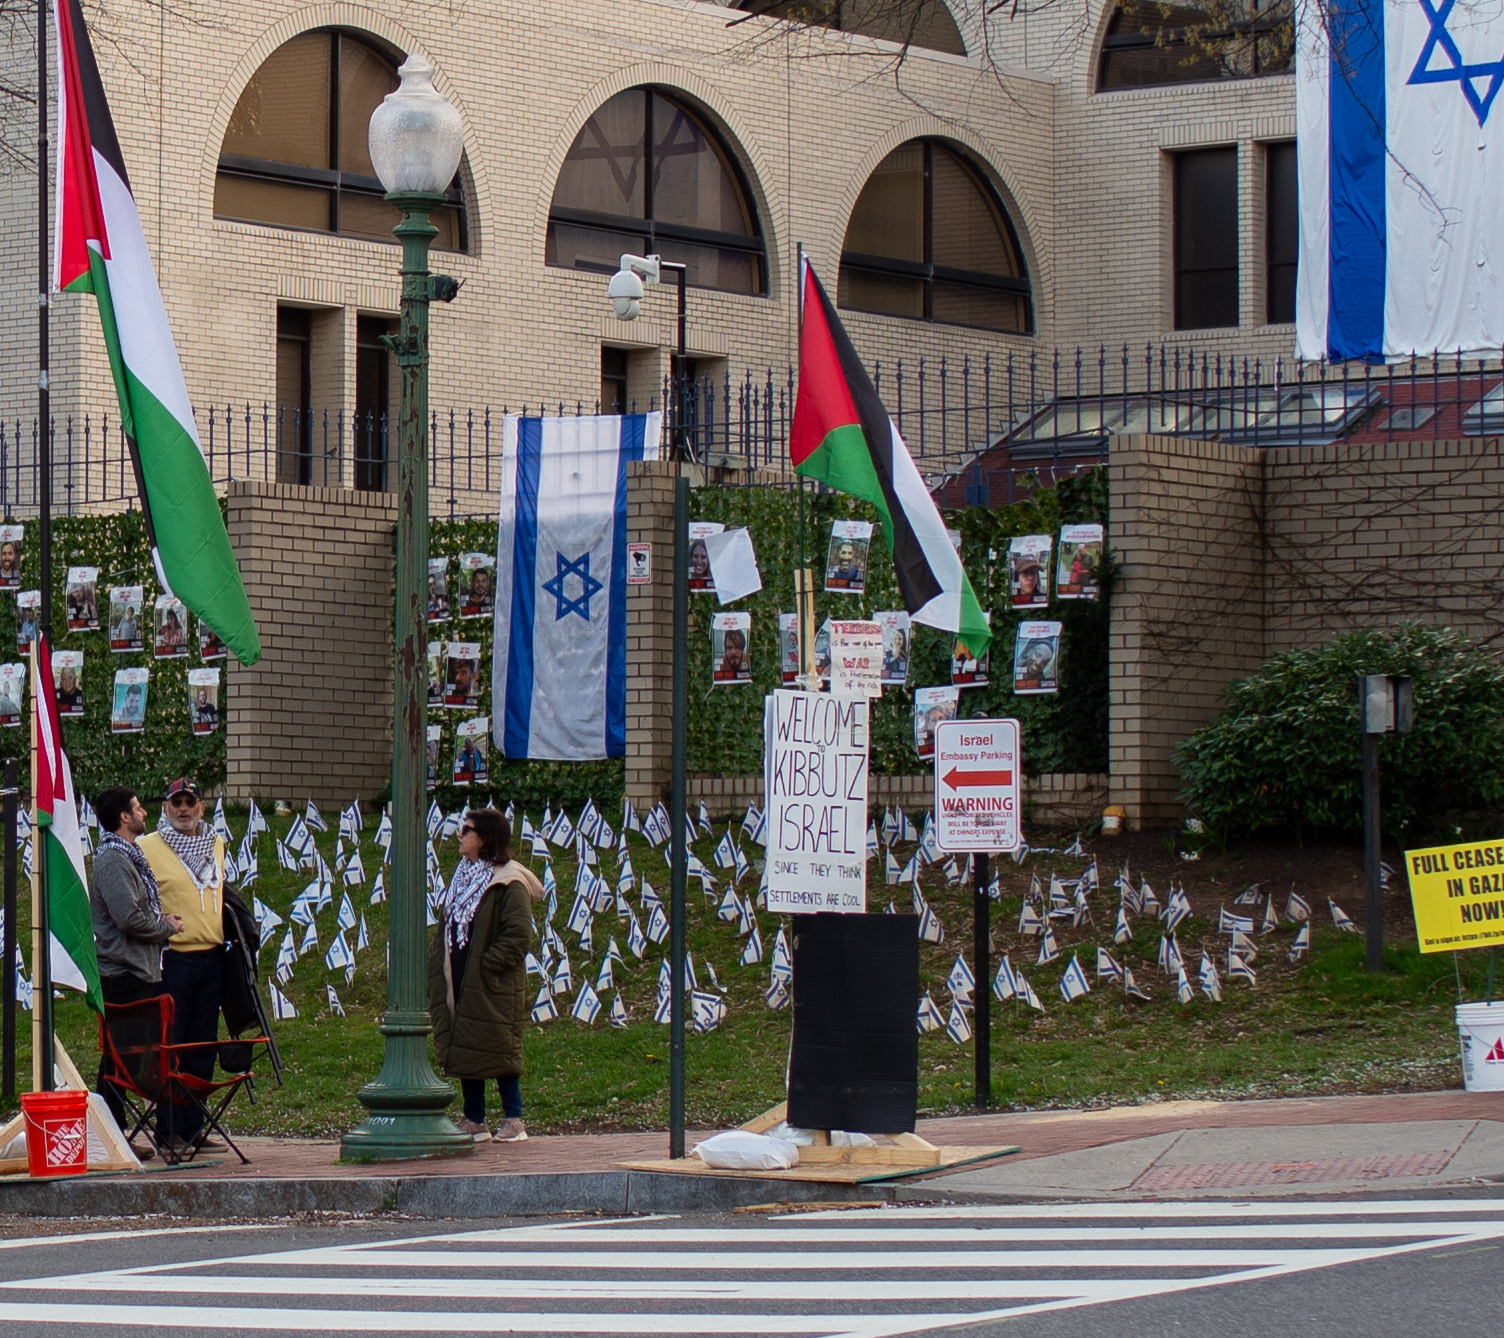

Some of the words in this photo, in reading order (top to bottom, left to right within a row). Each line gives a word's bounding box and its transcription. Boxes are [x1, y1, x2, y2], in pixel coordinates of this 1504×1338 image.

[843, 657, 869, 669] WAR
[777, 695, 866, 748] WELCOME
[818, 744, 825, 753] TO
[960, 734, 993, 746] Israel
[941, 752, 978, 761] Embassy
[981, 751, 1012, 761] Parking
[773, 749, 866, 801] KIBBUTZ
[942, 797, 1013, 811] WARNING
[779, 804, 856, 854] ISRAEL
[774, 861, 798, 875] SINCE
[810, 863, 832, 878] THEY
[838, 865, 862, 879] THINK
[1412, 854, 1449, 875] FULL
[1447, 878, 1464, 898] IN
[770, 890, 822, 906] SETTLEMENTS
[826, 893, 839, 906] ARE
[842, 894, 861, 906] COOL
[48, 1119, 85, 1165] HOME
